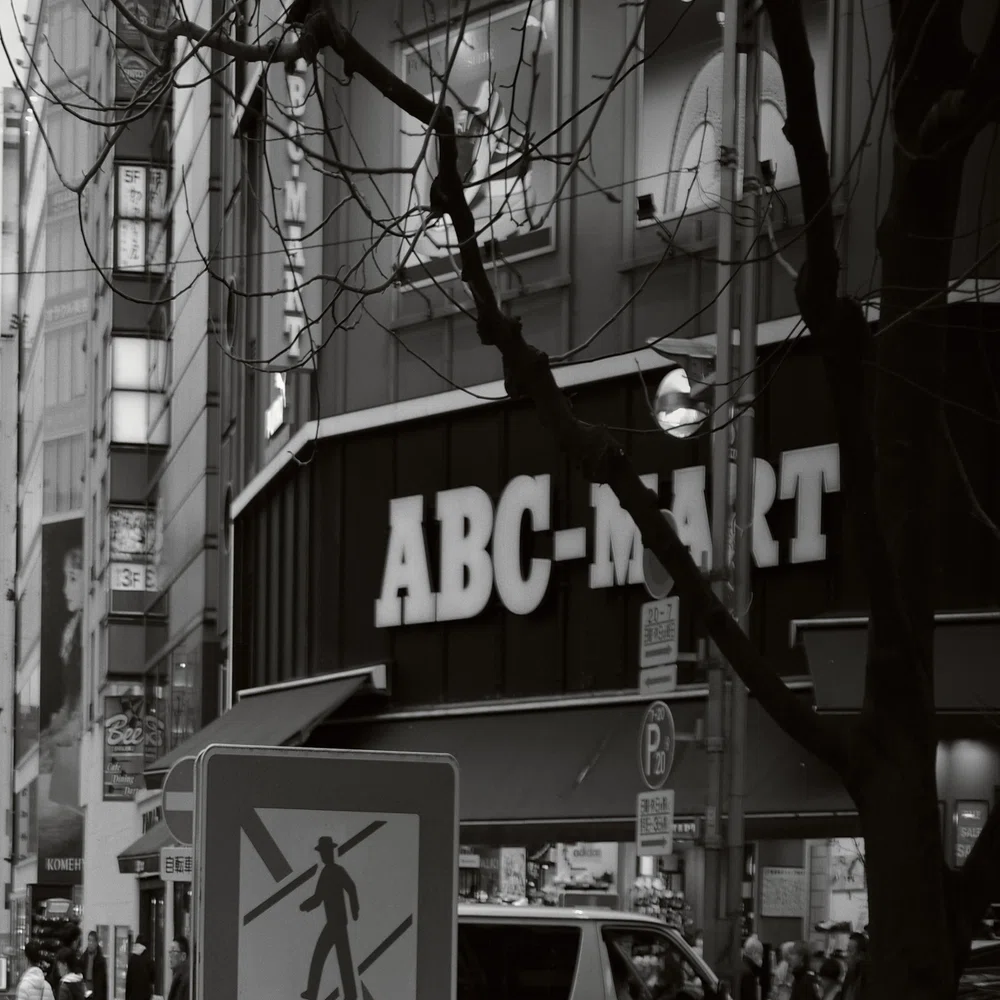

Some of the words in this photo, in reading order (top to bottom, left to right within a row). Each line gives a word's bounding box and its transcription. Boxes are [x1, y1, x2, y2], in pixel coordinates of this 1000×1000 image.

[124, 169, 140, 183] 5F
[374, 443, 840, 628] ABC-MART
[121, 568, 141, 588] 3F
[105, 714, 144, 746] Bee
[645, 724, 660, 776] P
[655, 752, 665, 775] 20
[165, 856, 192, 873] 自転車
